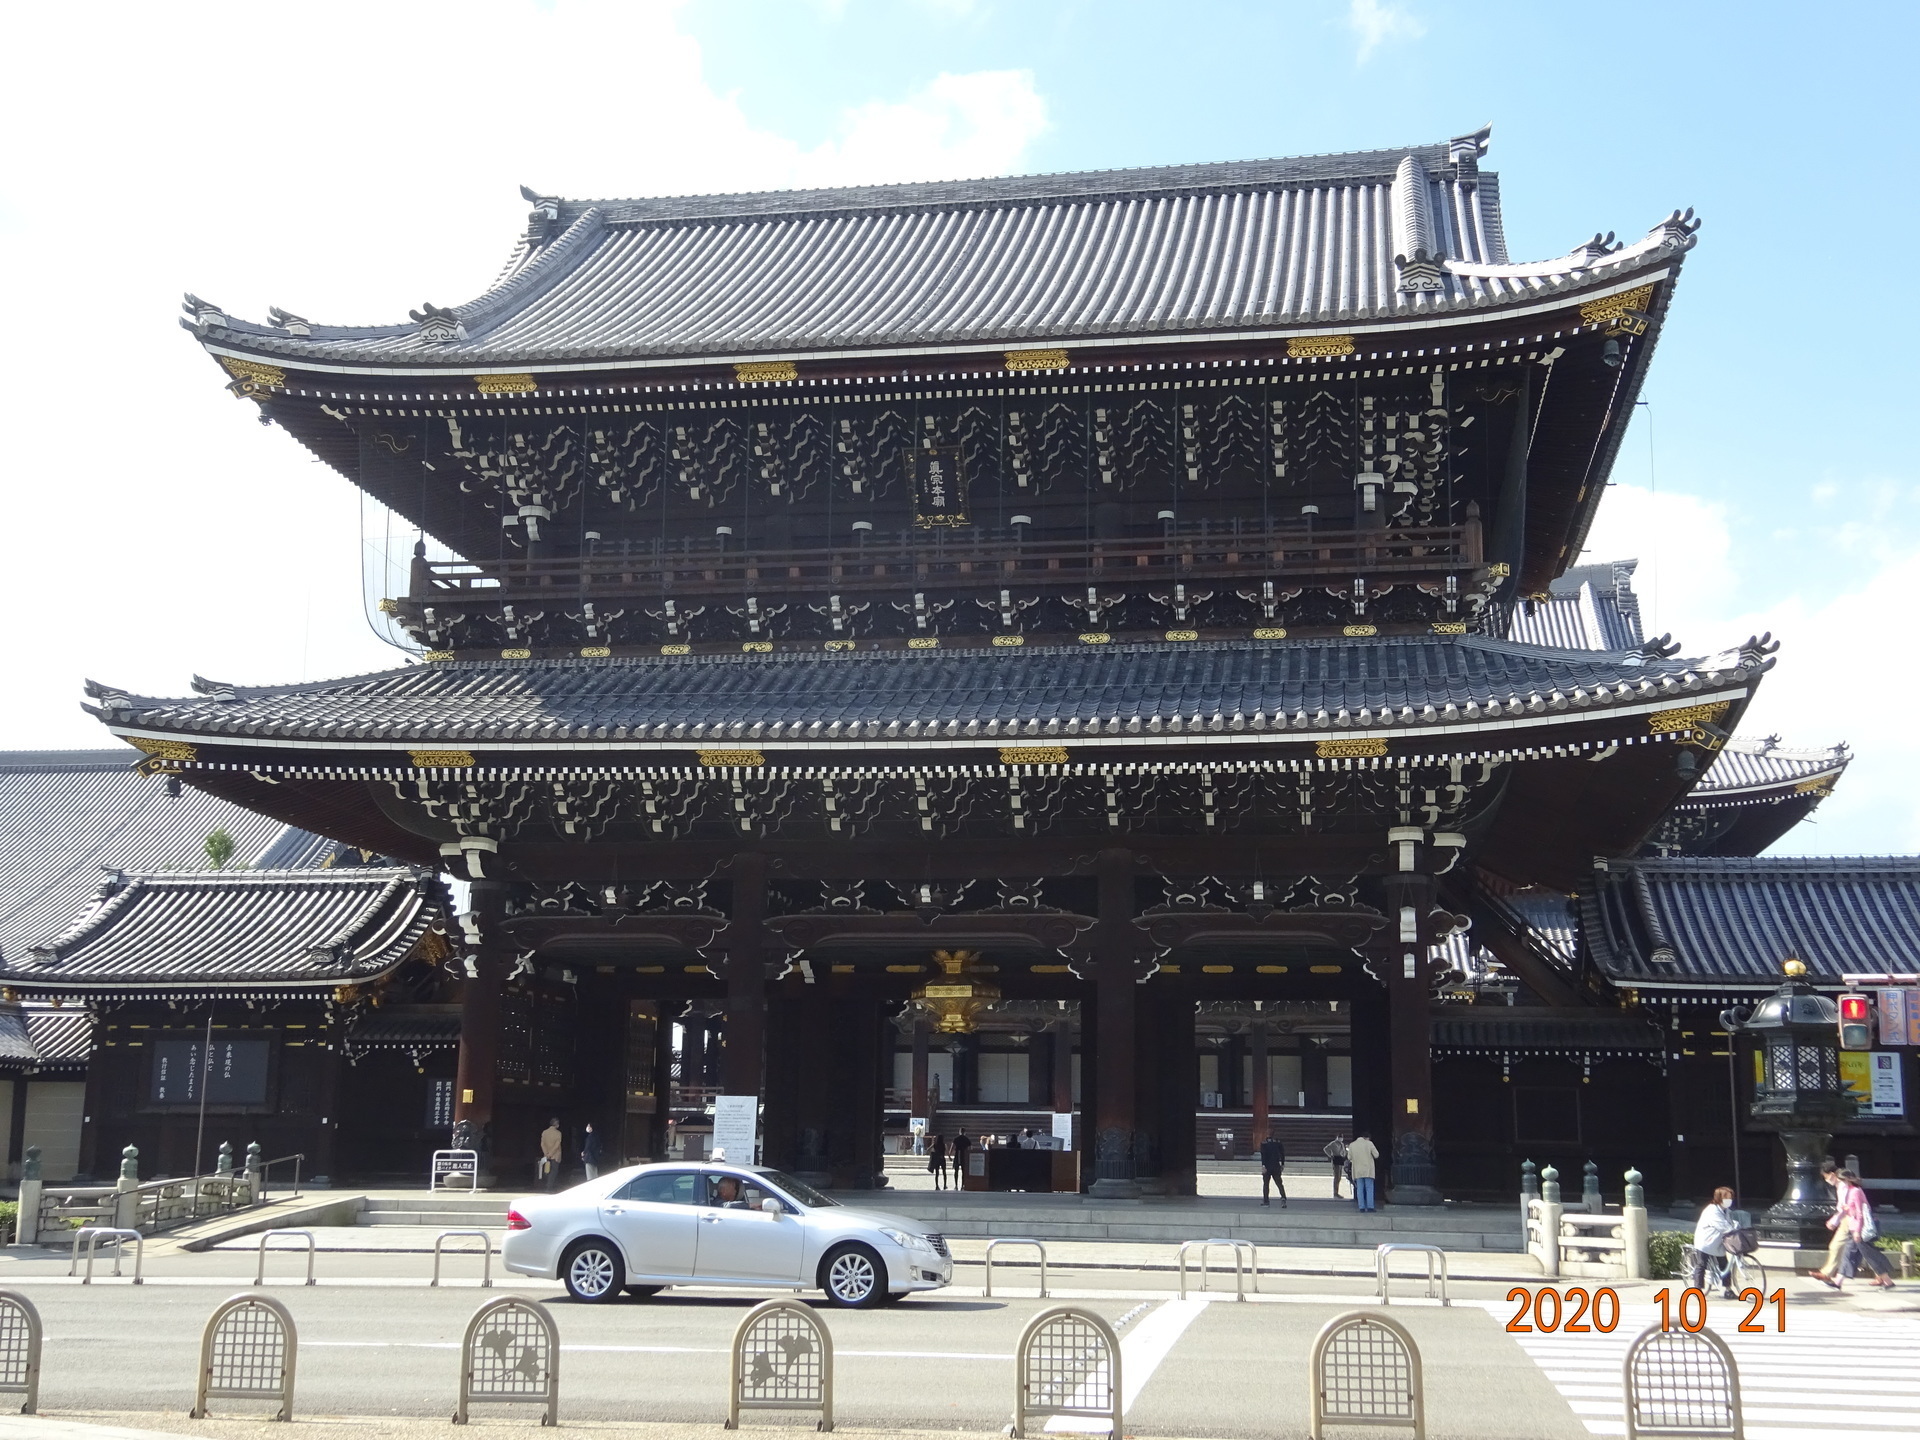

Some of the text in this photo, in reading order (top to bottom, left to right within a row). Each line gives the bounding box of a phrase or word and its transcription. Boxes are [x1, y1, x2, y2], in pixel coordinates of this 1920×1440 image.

[1886, 992, 1900, 1041] 押ボタン式
[187, 1044, 197, 1099] あい念じたまえり
